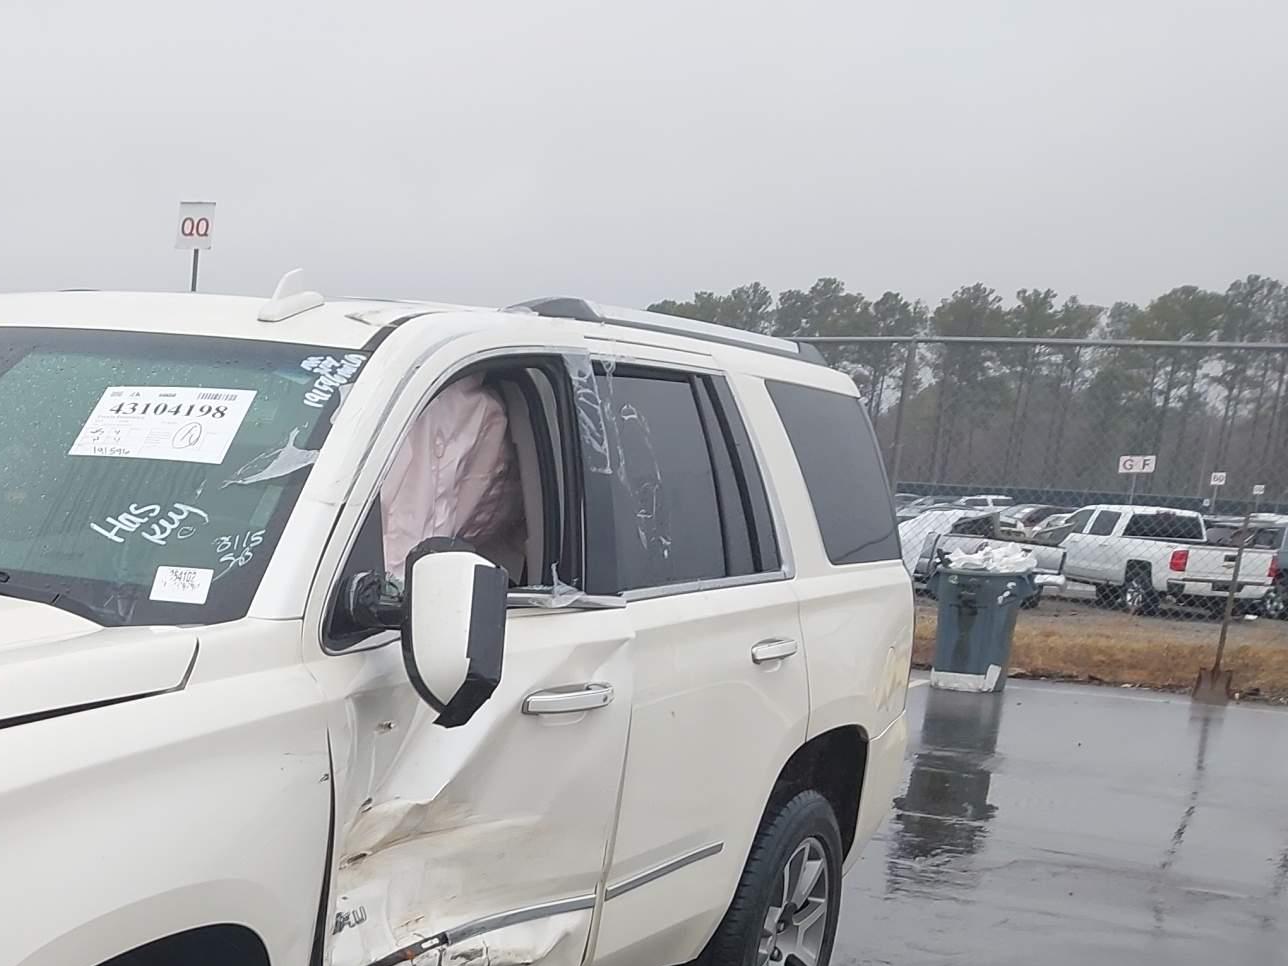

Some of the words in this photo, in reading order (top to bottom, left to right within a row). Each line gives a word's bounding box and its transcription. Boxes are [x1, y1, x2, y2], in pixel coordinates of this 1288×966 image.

[181, 217, 209, 237] QQ
[109, 402, 228, 419] 43104198
[1122, 459, 1134, 471] G
[1142, 458, 1151, 471] F
